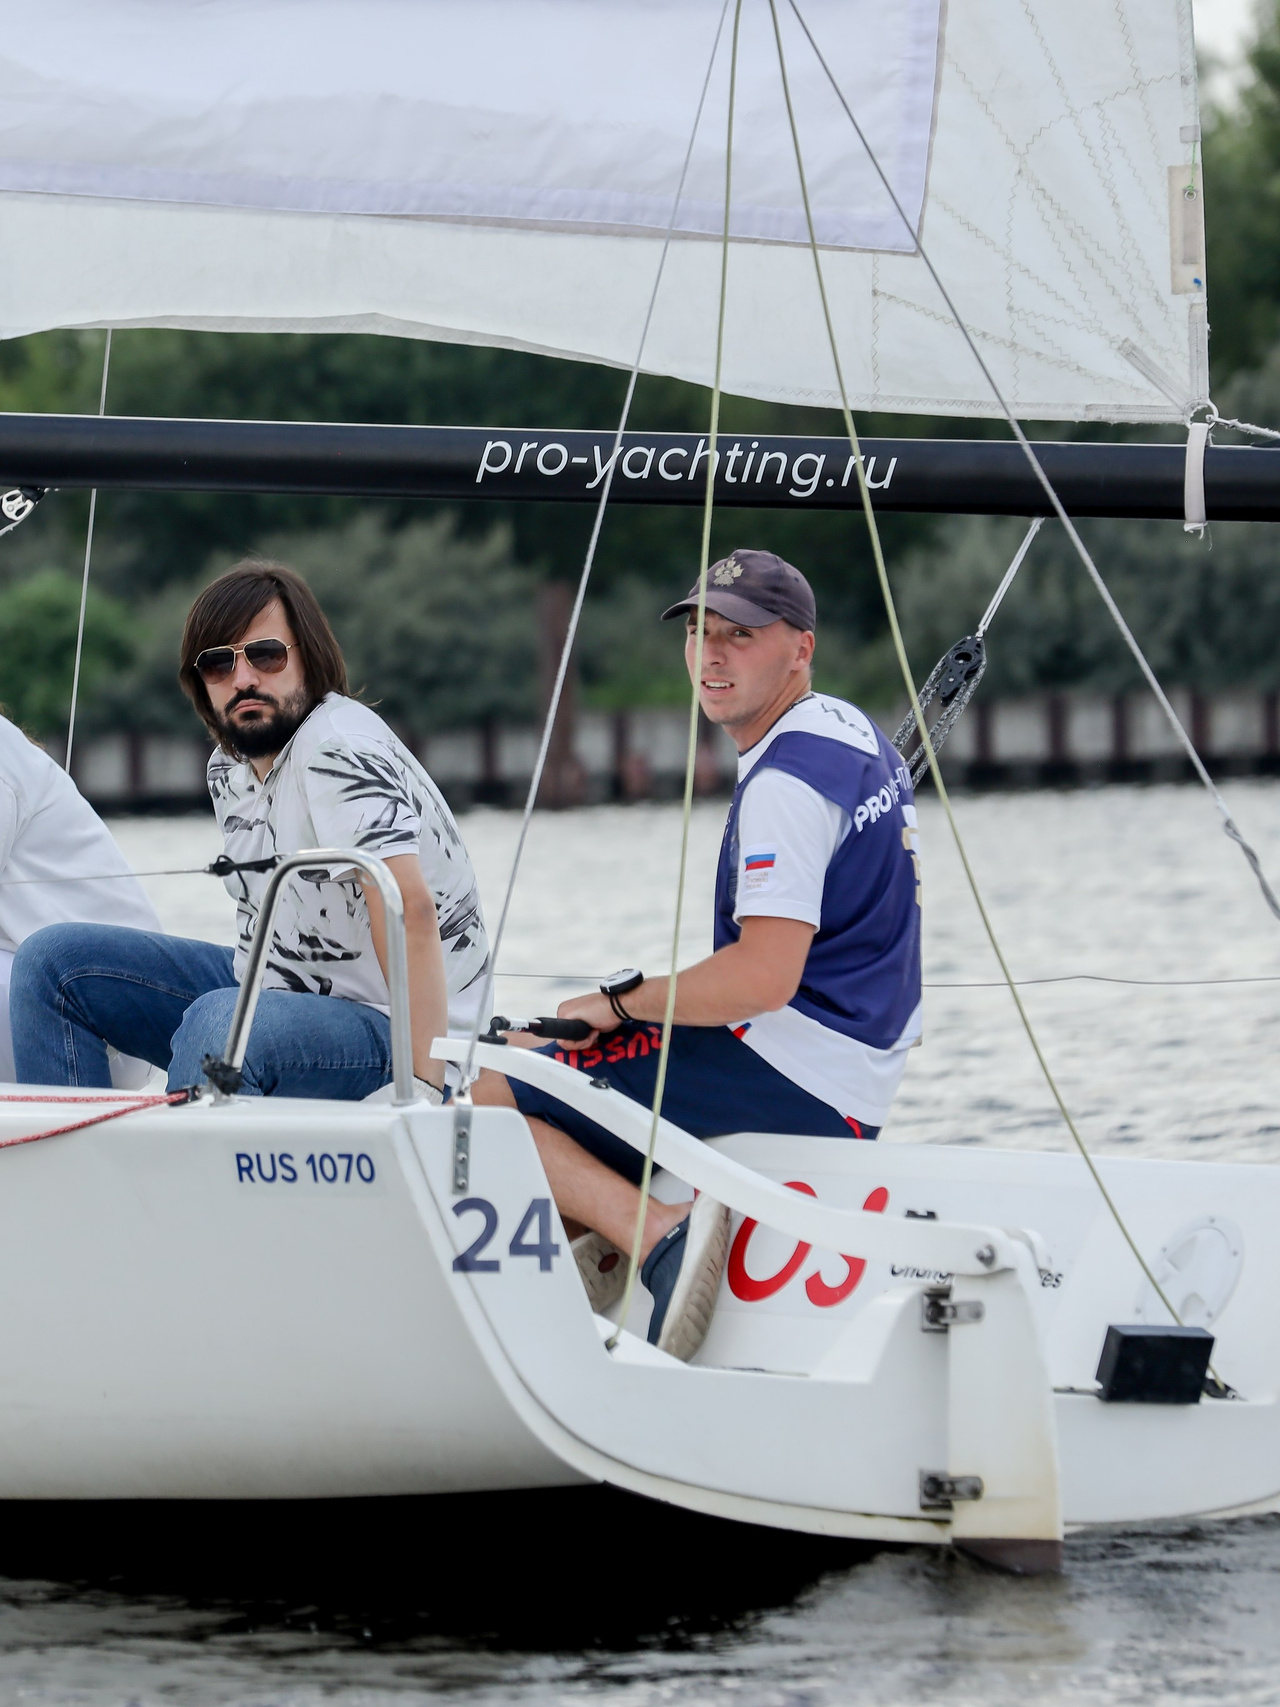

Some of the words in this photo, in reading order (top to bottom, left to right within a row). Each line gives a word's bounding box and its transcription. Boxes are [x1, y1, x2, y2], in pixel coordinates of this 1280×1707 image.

[476, 439, 898, 498] pro-yachting.ru
[235, 1153, 298, 1183] RUS
[306, 1153, 376, 1183] 1070
[451, 1197, 560, 1274] 24
